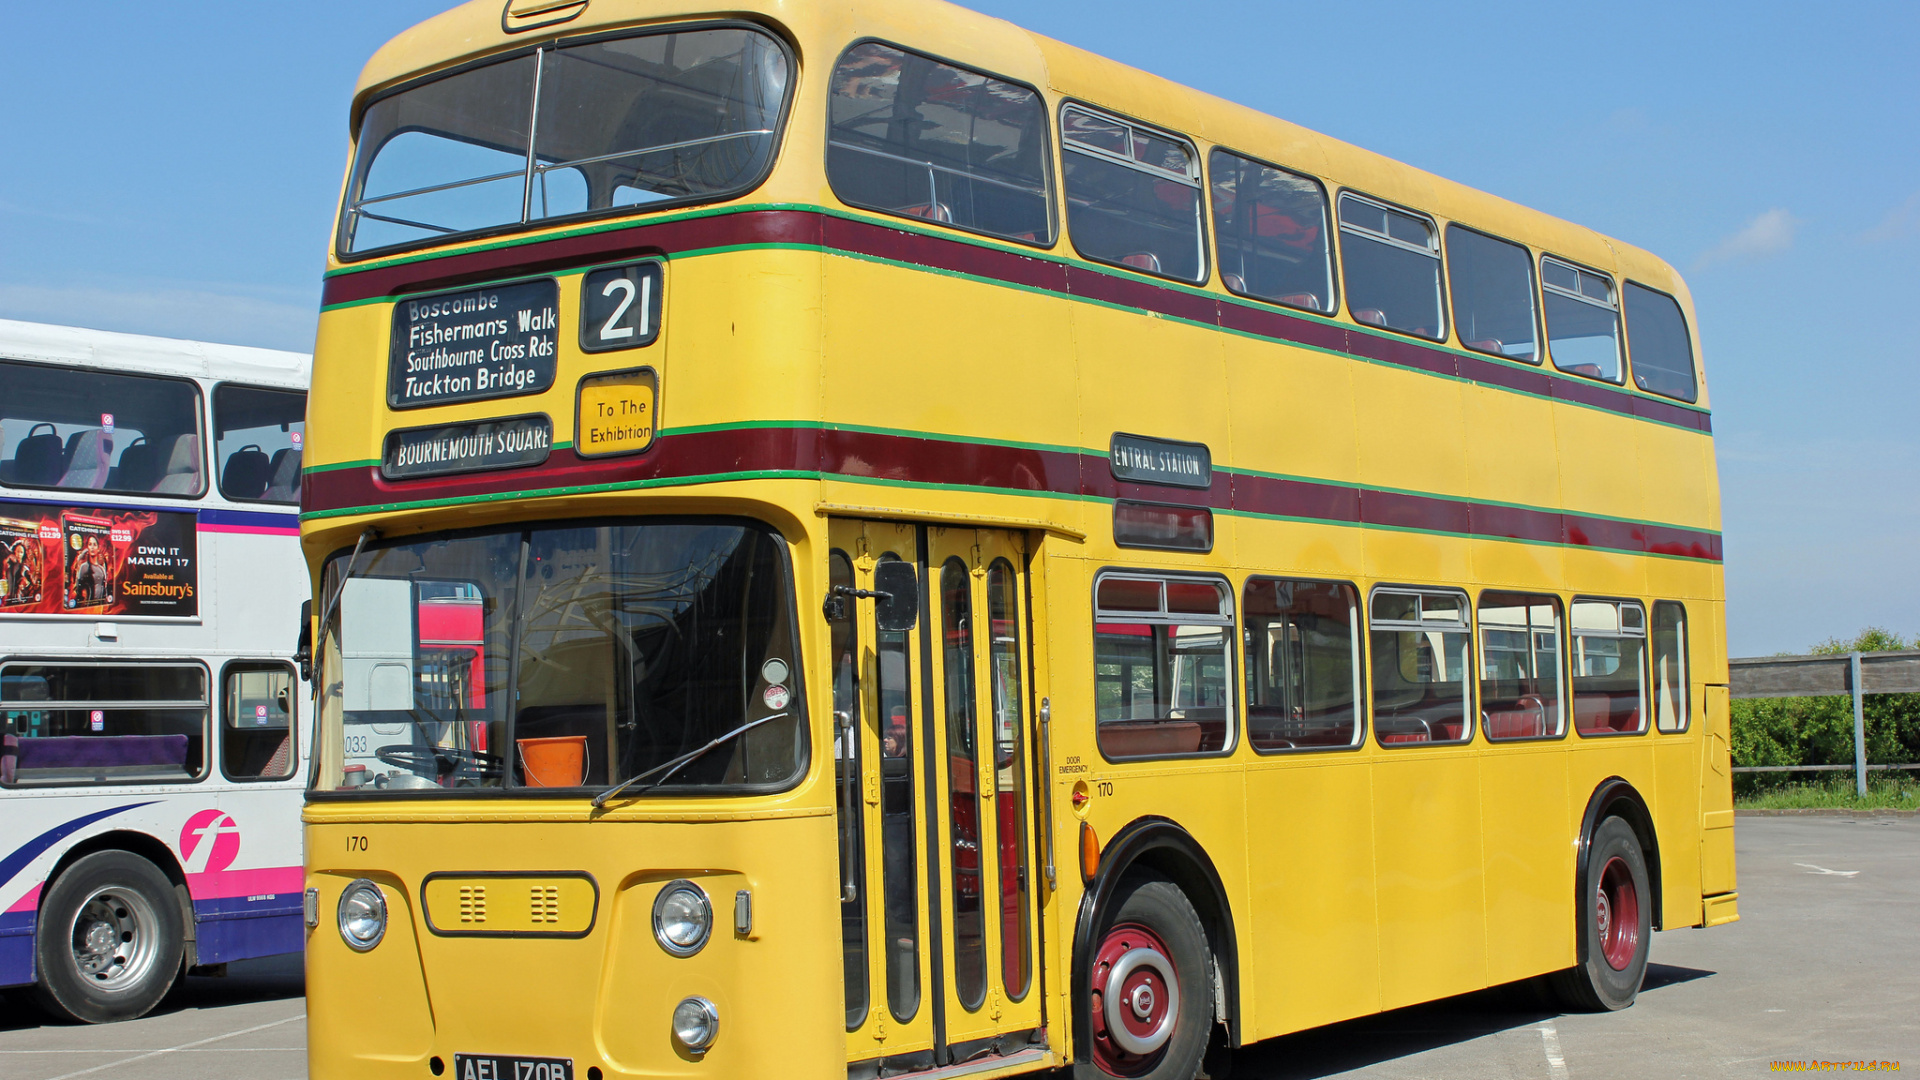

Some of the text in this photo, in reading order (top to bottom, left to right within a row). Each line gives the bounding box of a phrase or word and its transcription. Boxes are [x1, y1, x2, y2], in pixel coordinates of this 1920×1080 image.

[409, 291, 499, 322] Boscombe
[600, 275, 651, 340] 21
[410, 307, 556, 349] Fisherman's Walk
[407, 335, 554, 373] Southbourne Cross Rds
[406, 364, 536, 398] Tuckton Bridge
[597, 399, 646, 418] To The
[590, 424, 651, 443] Exhibition
[397, 425, 549, 467] BOURNEMOUTH SQUARE
[1114, 444, 1200, 476] ENTRAL STATION
[40, 531, 61, 539] £12.99
[111, 534, 132, 542] £12.99
[138, 546, 179, 556] OWN IT
[127, 557, 189, 567] MARCH 17
[122, 580, 193, 600] Sainsbury's
[345, 735, 367, 752] 033
[1058, 765, 1088, 774] EMERGENCY
[1066, 756, 1080, 765] DOOR
[1097, 782, 1113, 797] 170
[346, 836, 368, 851] 170
